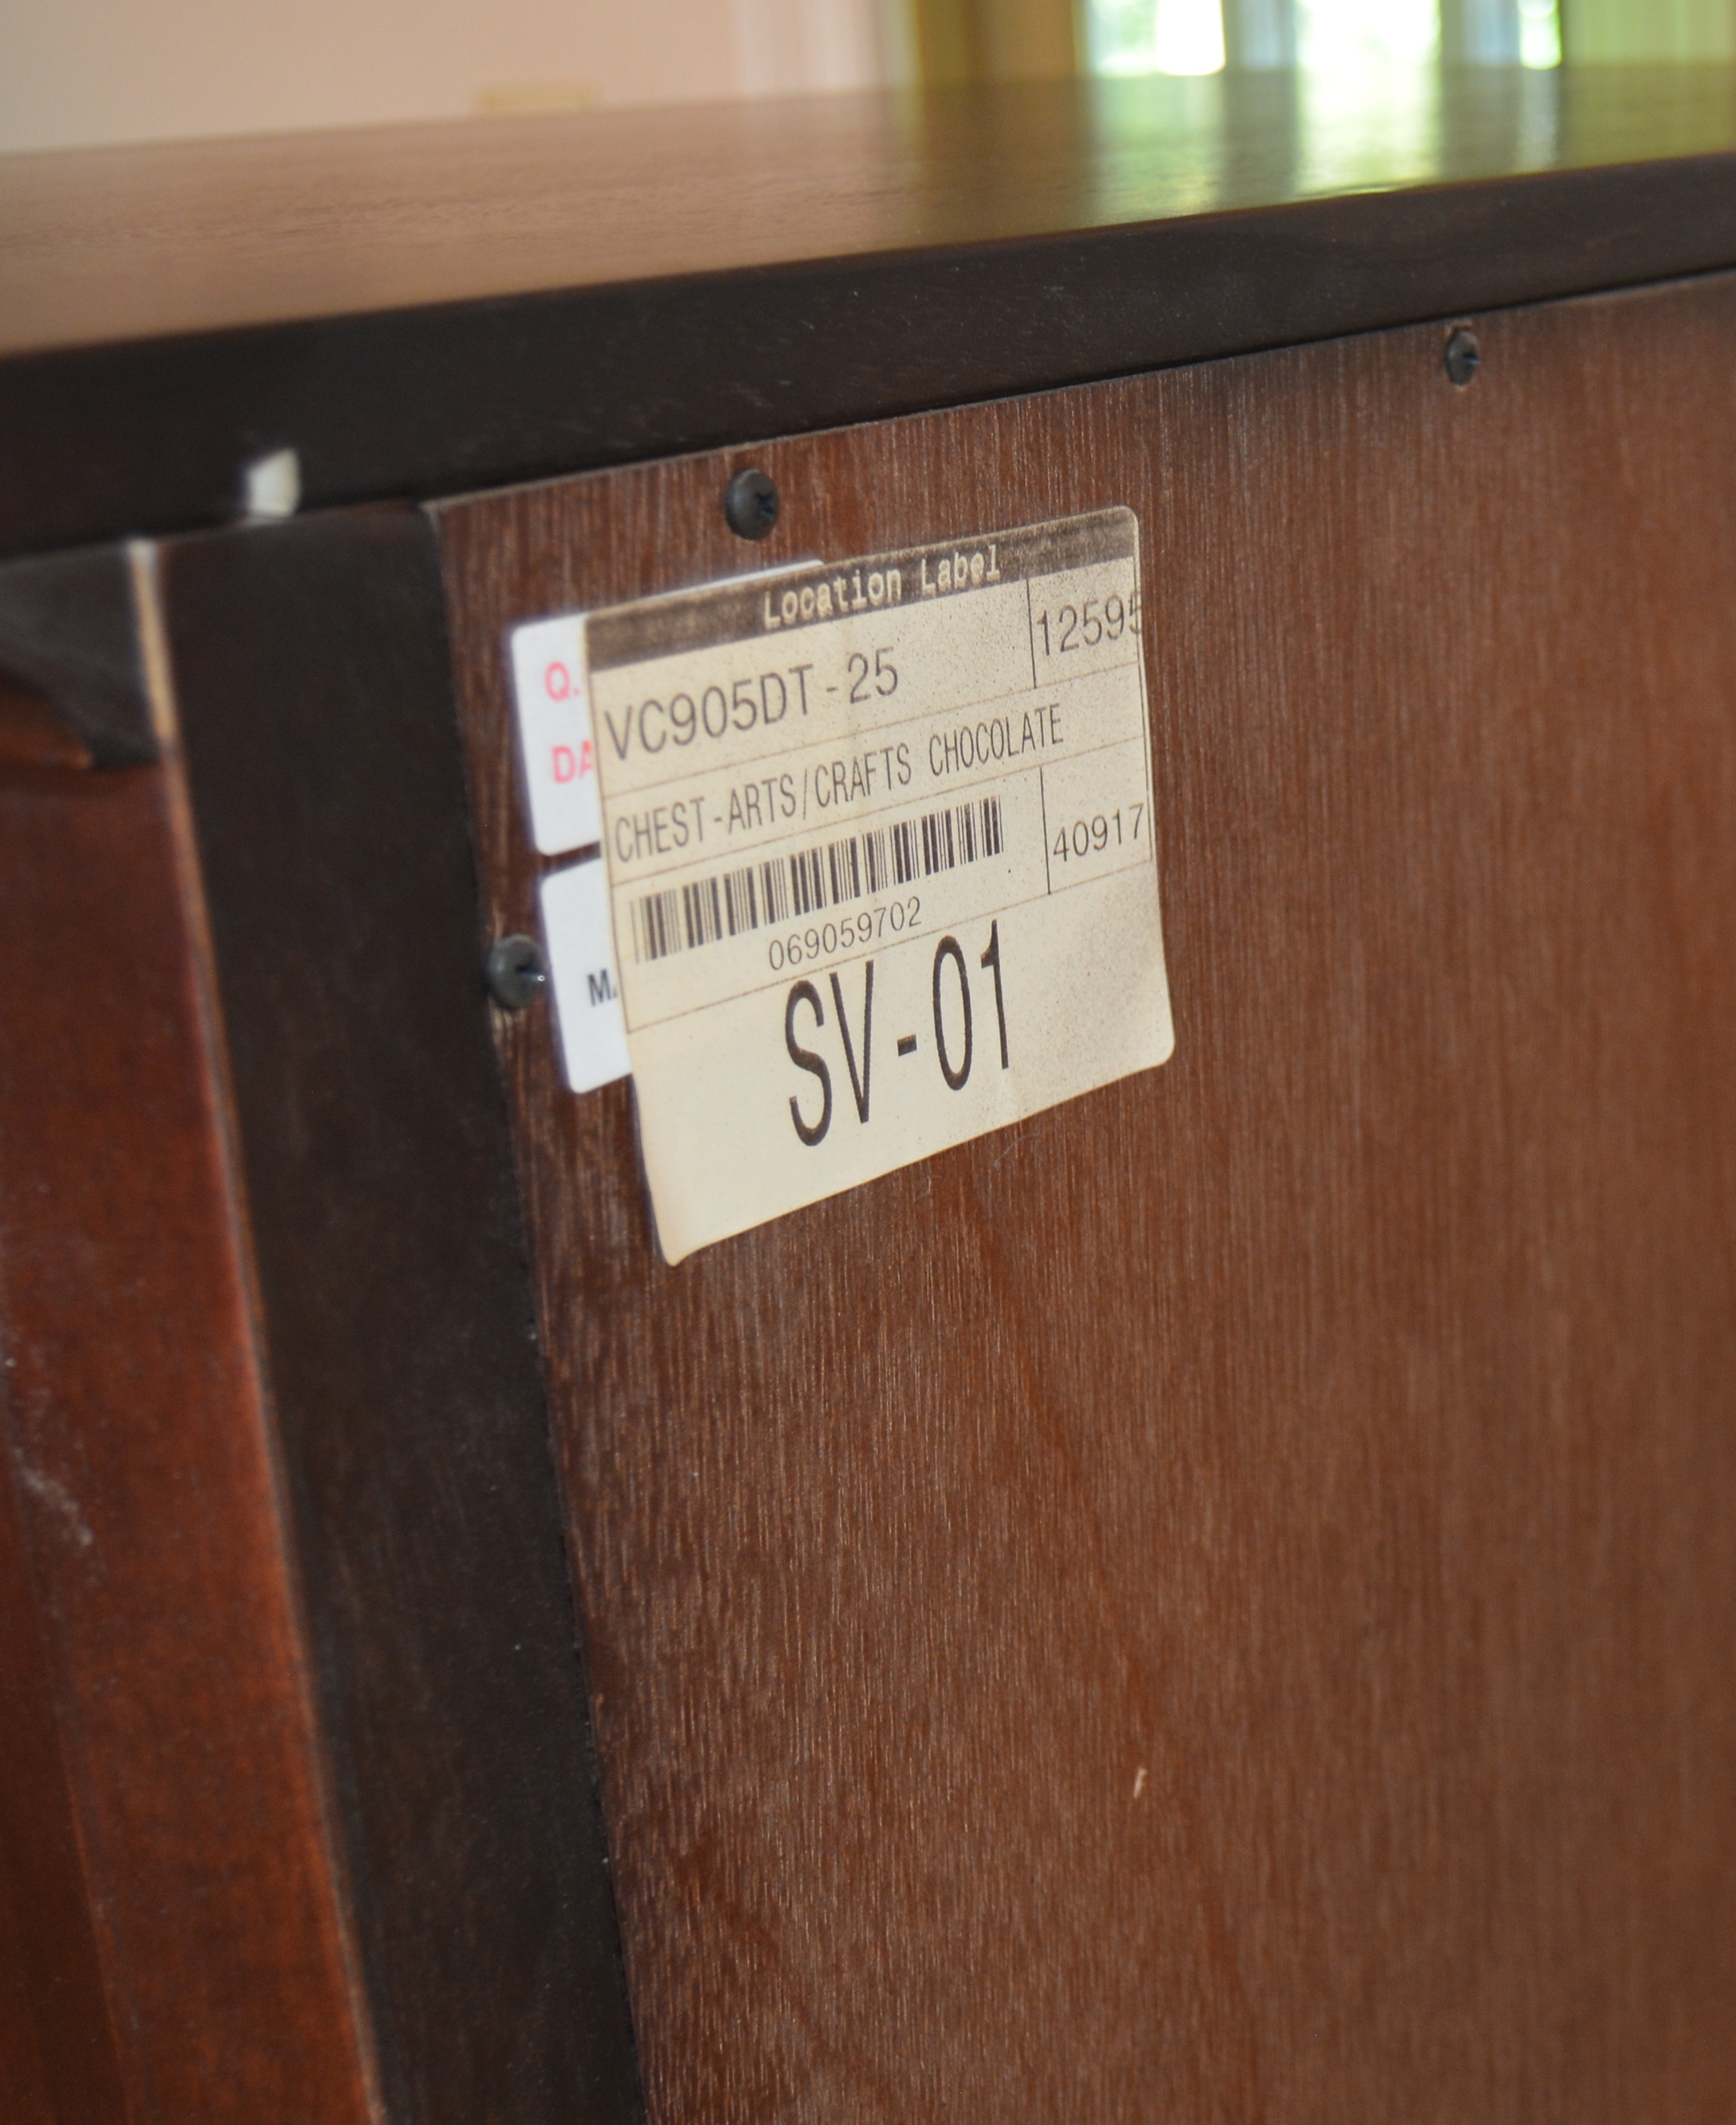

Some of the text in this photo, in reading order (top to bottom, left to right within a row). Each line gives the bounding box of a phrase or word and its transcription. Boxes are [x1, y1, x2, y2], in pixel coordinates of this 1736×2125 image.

[764, 544, 1001, 630] Location Label
[615, 703, 1064, 864] CHEST-ARTS/CRAFTS CHOCOLATE
[1053, 803, 1144, 863] 40917
[769, 896, 922, 971] 069059702
[785, 918, 1009, 1147] SV-01
